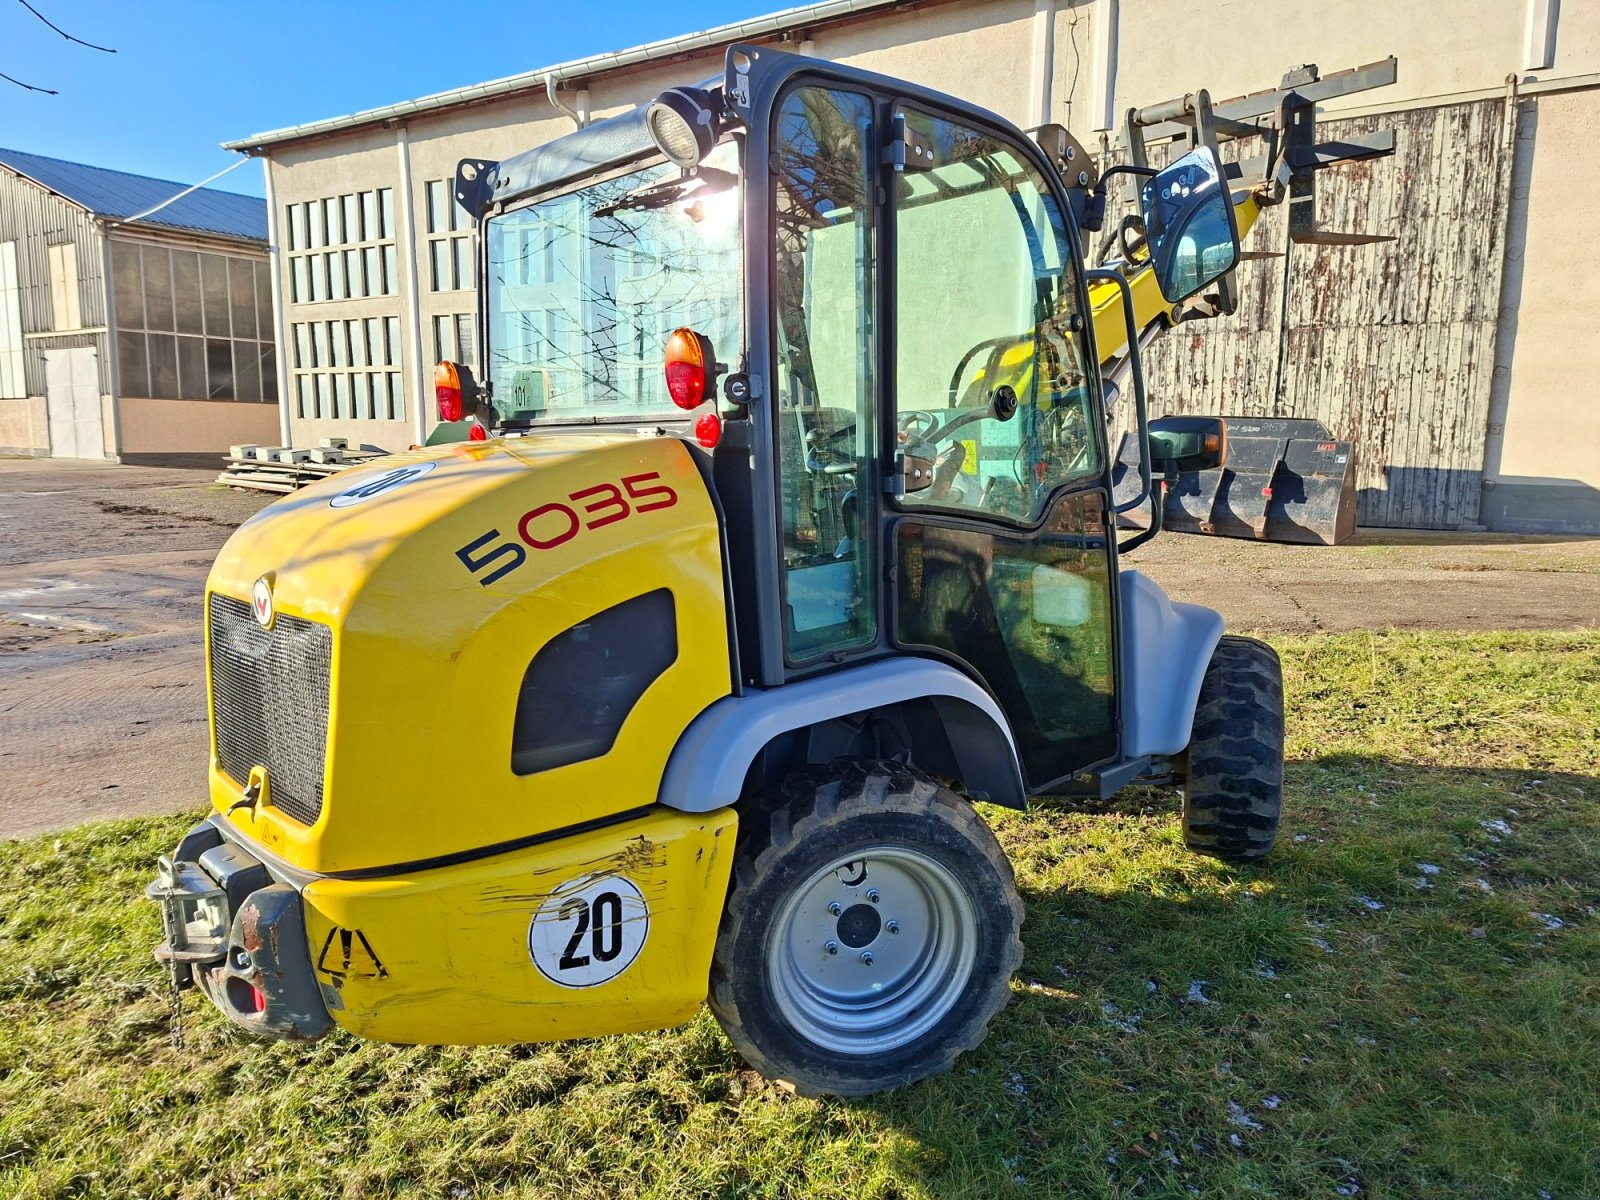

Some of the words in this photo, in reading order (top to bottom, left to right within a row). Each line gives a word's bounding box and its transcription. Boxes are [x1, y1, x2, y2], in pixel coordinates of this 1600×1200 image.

[515, 385, 526, 407] 101
[343, 468, 421, 498] 20
[455, 471, 678, 587] 5035
[558, 891, 622, 971] 20
